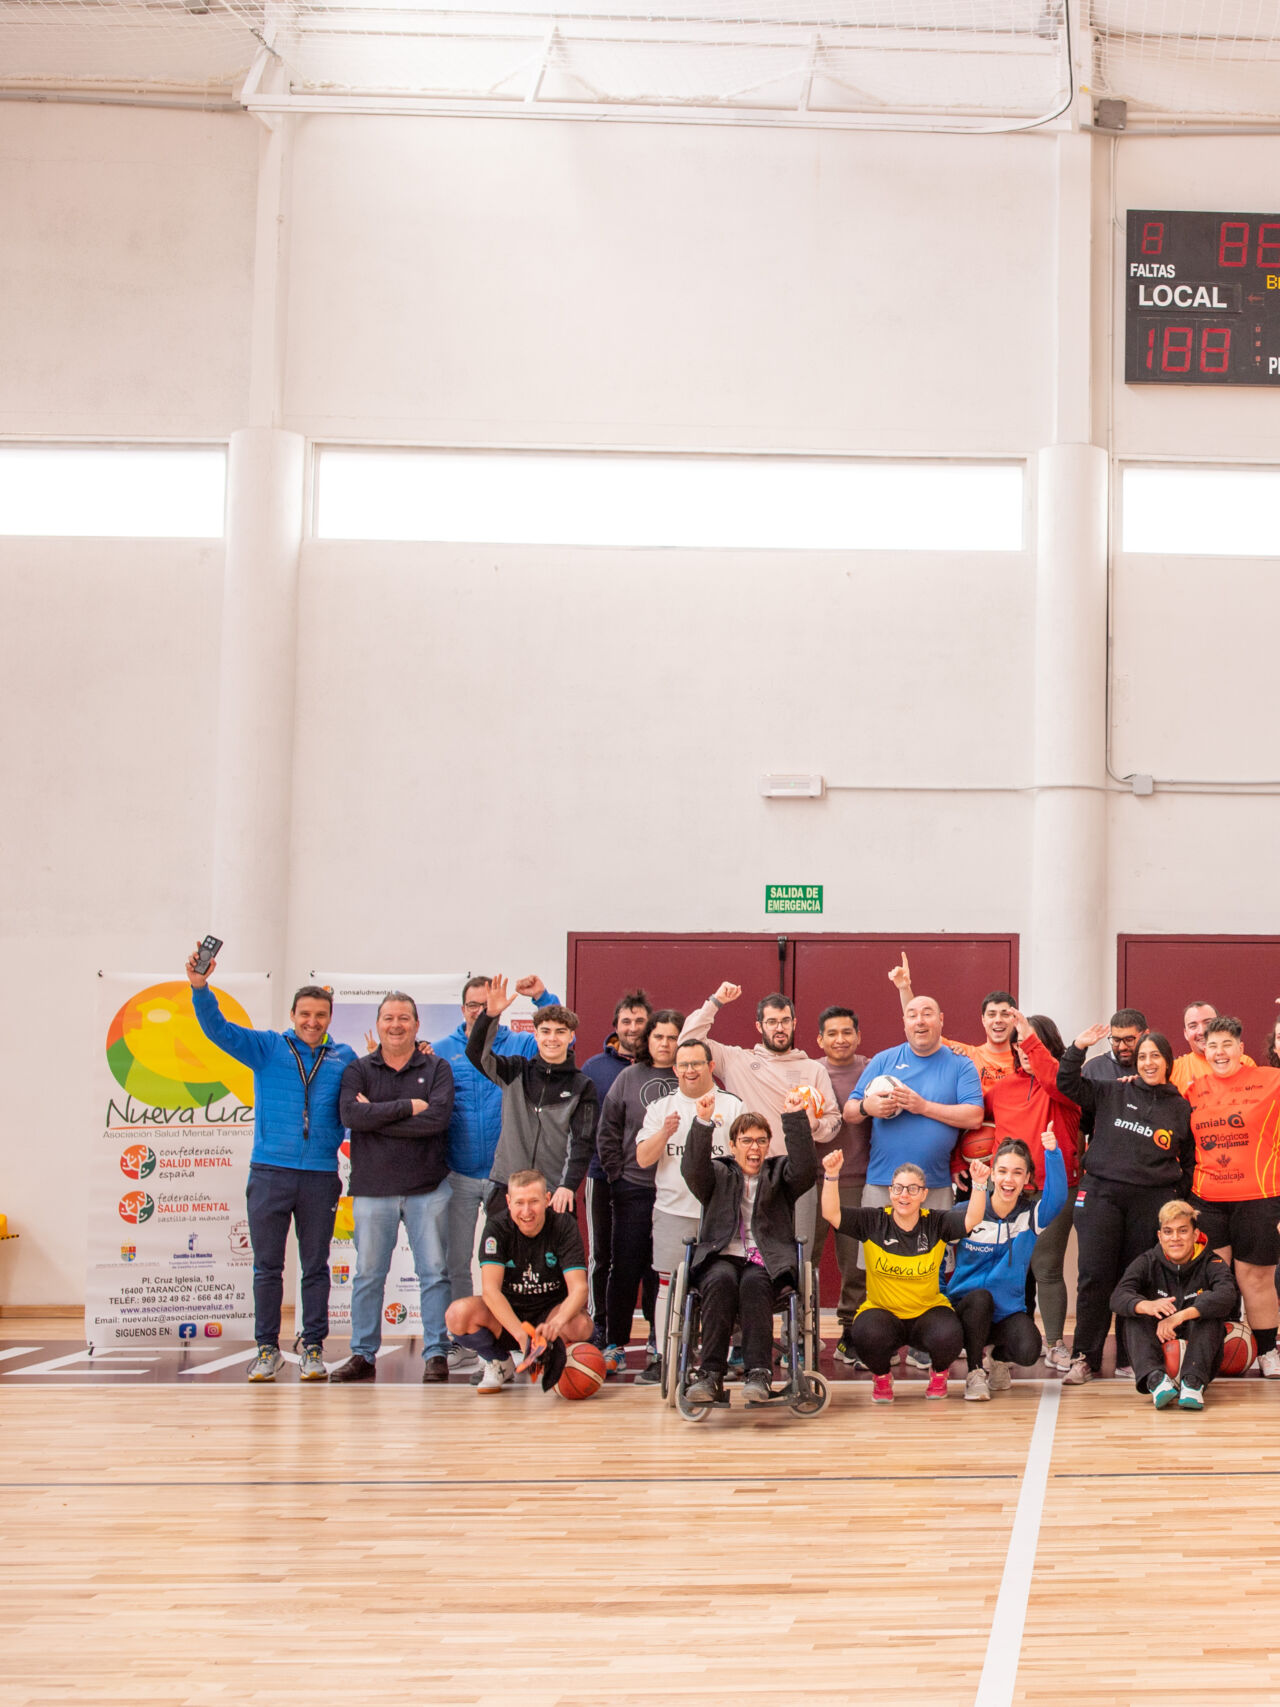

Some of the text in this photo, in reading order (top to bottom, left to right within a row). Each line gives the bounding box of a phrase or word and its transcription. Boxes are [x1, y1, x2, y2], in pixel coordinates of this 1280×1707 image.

[1130, 263, 1176, 279] FALTAS
[1138, 284, 1227, 309] LOCAL
[770, 887, 819, 899] SALIDA DE
[767, 899, 821, 911] EMERGENCIA
[106, 1093, 255, 1128] Nueva Luz
[1114, 1118, 1153, 1138] amiab
[1195, 1117, 1226, 1130] amiab
[102, 1127, 254, 1139] Asociación Salud Mental Tarancó
[159, 1146, 234, 1160] confederación
[159, 1157, 233, 1169] SALUD MENTAL
[158, 1170, 195, 1181] españa
[156, 1192, 212, 1204] federación
[157, 1202, 230, 1213] SALUD MENTAL
[875, 1257, 913, 1275] Nueva
[142, 1277, 152, 1285] Pl.
[154, 1276, 173, 1284] Cruz
[205, 1275, 215, 1283] 10
[120, 1284, 236, 1295] 16400 TARANCÓN (CUENCA)
[141, 1296, 156, 1304] 969
[158, 1295, 167, 1303] 32
[169, 1295, 179, 1303] 49
[197, 1293, 211, 1302] 666
[213, 1293, 223, 1301] 48
[224, 1292, 234, 1300] 47
[236, 1292, 246, 1300] 82
[120, 1303, 234, 1315] www.asociacion-nuevaluz.es
[95, 1316, 120, 1325] Email:
[158, 1326, 173, 1337] EN:
